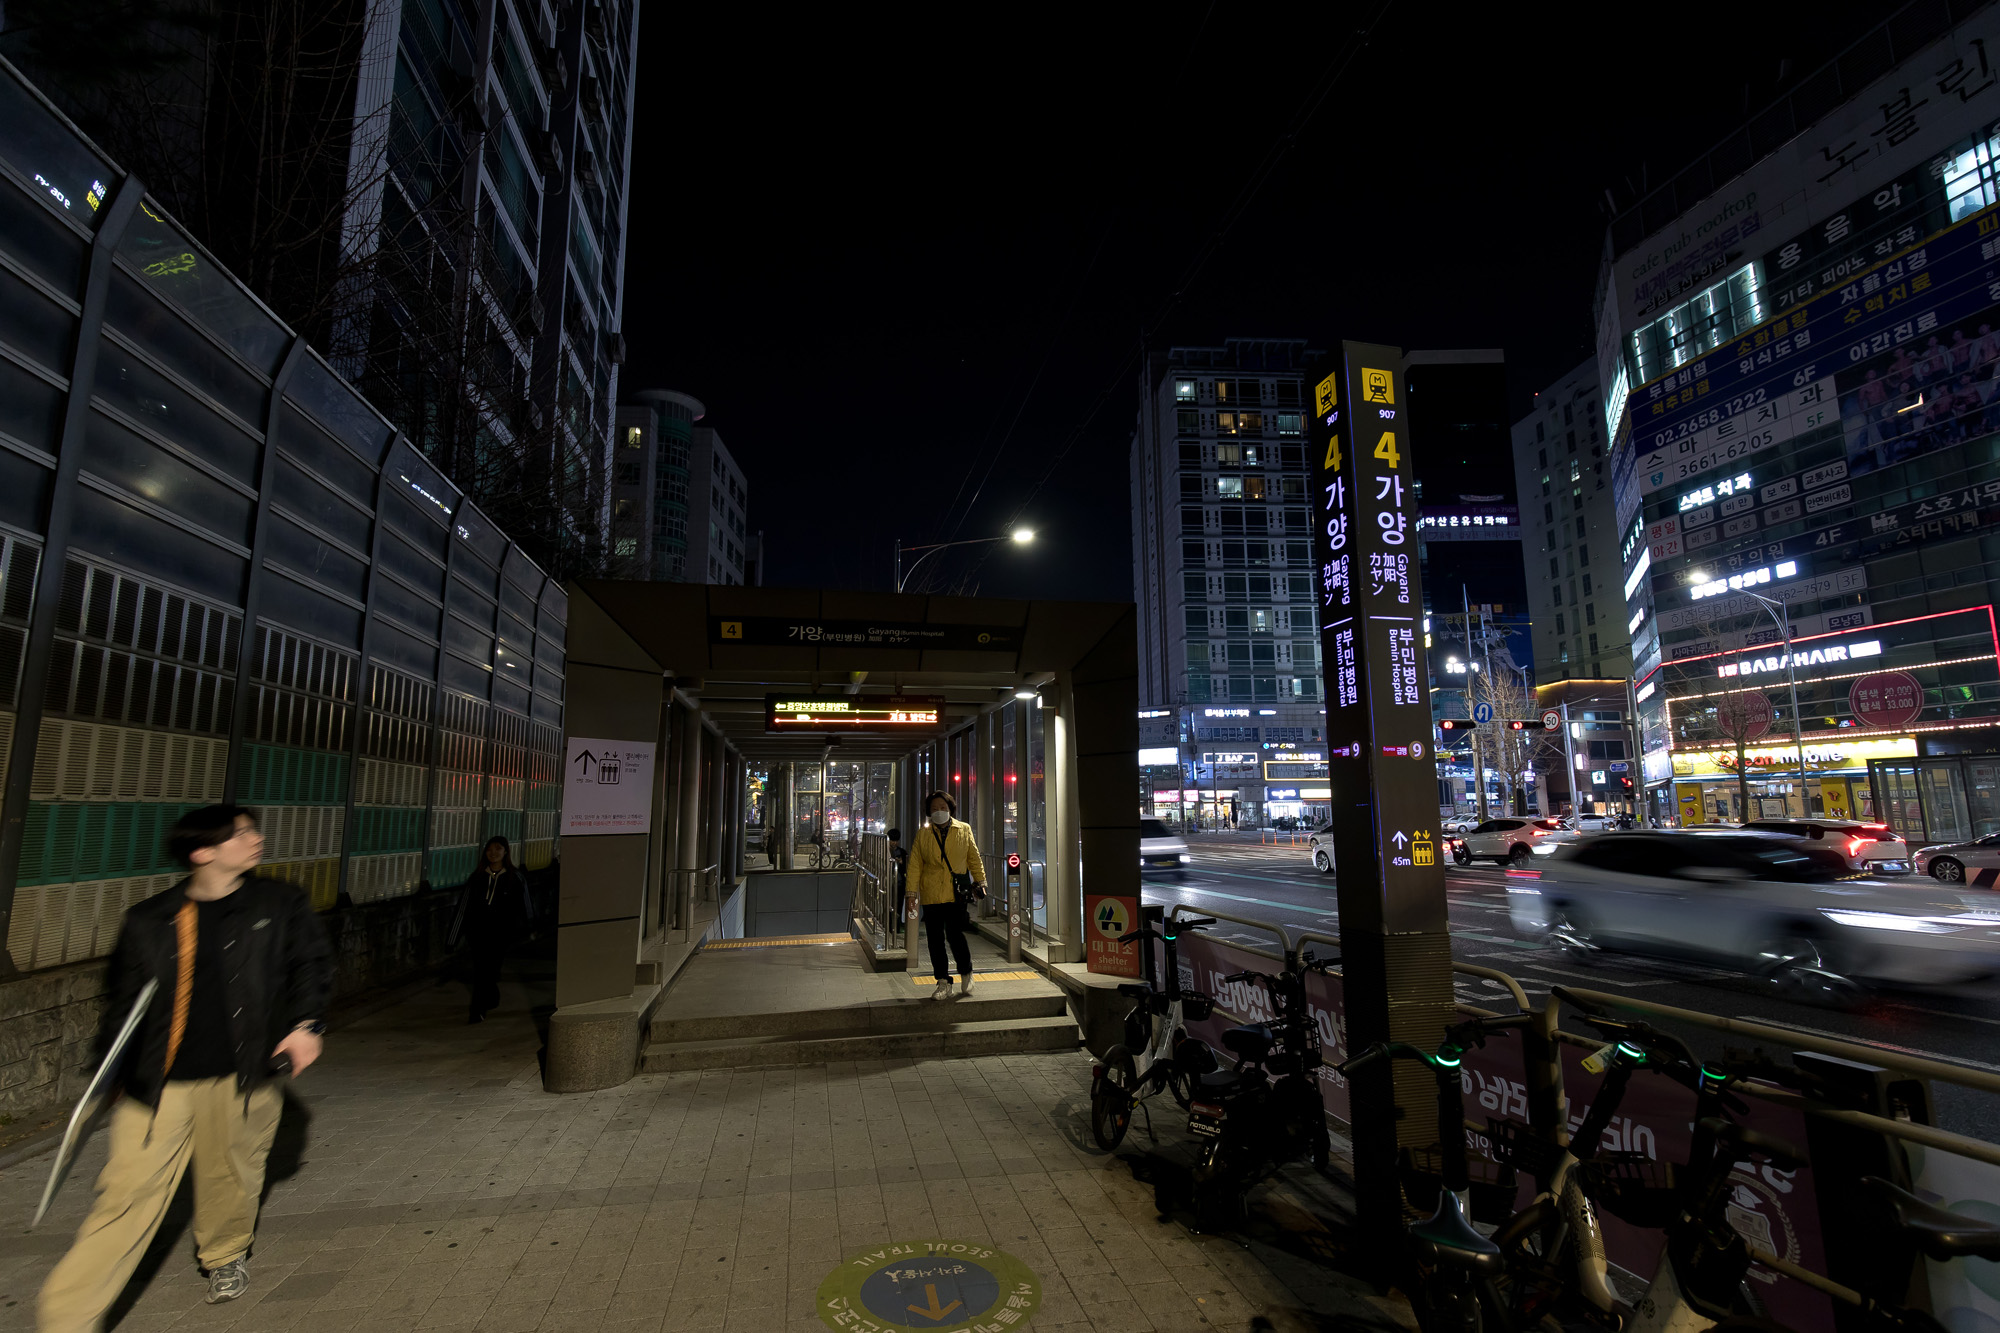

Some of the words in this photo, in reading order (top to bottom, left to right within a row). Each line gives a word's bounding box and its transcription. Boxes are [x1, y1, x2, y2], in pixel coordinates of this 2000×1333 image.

[1633, 253, 1659, 279] cafe
[1664, 233, 1691, 264] pub
[1696, 191, 1757, 238] rooftop
[1634, 212, 1760, 303] 세계맥주전문점
[1779, 281, 1813, 307] 기타
[1822, 257, 1866, 285] 피아노
[1874, 226, 1916, 256] 작곡
[1650, 361, 1707, 399] 두통비염
[1737, 310, 1808, 356] 소화불량
[1840, 249, 1927, 305] 자율신경
[1850, 311, 1939, 360] 야간진료
[1652, 378, 1710, 416] 척추관절
[1739, 330, 1811, 375] 위식도염
[1843, 272, 1932, 324] 수액치료
[1327, 411, 1338, 426] 907
[1379, 409, 1395, 419] 907
[1655, 388, 1767, 447] 02.2658.1222
[1793, 365, 1816, 387] 6F
[1324, 434, 1342, 472] 4
[1373, 432, 1400, 468] 4
[1679, 430, 1773, 476] 3661-6205
[1806, 412, 1824, 428] 5F
[1689, 510, 1709, 523] 추나
[1726, 497, 1748, 510] 비만
[1767, 483, 1791, 497] 보약
[1805, 466, 1845, 484] 교통사고
[1717, 473, 1752, 495] 치과
[1326, 476, 1347, 550] 가양
[1376, 474, 1407, 545] 가양
[1729, 519, 1751, 532] 여성
[1806, 488, 1850, 509] 안면비대칭
[1915, 496, 1956, 519] 소호
[1651, 520, 1676, 539] 평일
[1816, 528, 1842, 546] 4F
[1896, 510, 1980, 544] 스터디카페
[1653, 541, 1678, 558] 야간
[1728, 543, 1784, 571] 한의원
[1332, 560, 1341, 589] 加阳
[1341, 555, 1350, 605] Gayang
[1369, 553, 1384, 595] カヤン
[1383, 553, 1396, 582] 加阳
[1397, 554, 1409, 604] Gayang
[1323, 564, 1333, 606] カヤン
[1771, 580, 1831, 600] 3662-7579
[1842, 574, 1859, 588] 3F
[727, 625, 737, 636] 4
[788, 626, 823, 641] 가양
[822, 633, 865, 643] (부민병원)
[868, 627, 900, 638] Gayang
[1831, 613, 1862, 628] 모낭염
[1389, 629, 1398, 661] Bumin
[1343, 629, 1357, 704] 부민병원
[1400, 628, 1419, 703] 부민병원
[1740, 646, 1847, 675] BABAHAIR
[1338, 667, 1347, 707] Hospital
[1391, 663, 1404, 705] Hospital
[1858, 689, 1878, 700] 염색
[1546, 717, 1556, 726] 50
[1860, 701, 1880, 713] 탈색
[1352, 743, 1360, 757] 9
[1413, 743, 1421, 757] 9
[1830, 808, 1844, 818] kt
[1392, 857, 1411, 866] 45m
[1092, 941, 1133, 955] 대피소
[1099, 955, 1128, 966] shelter
[853, 1244, 914, 1267] TRAIL
[924, 1243, 993, 1259] SEOUL
